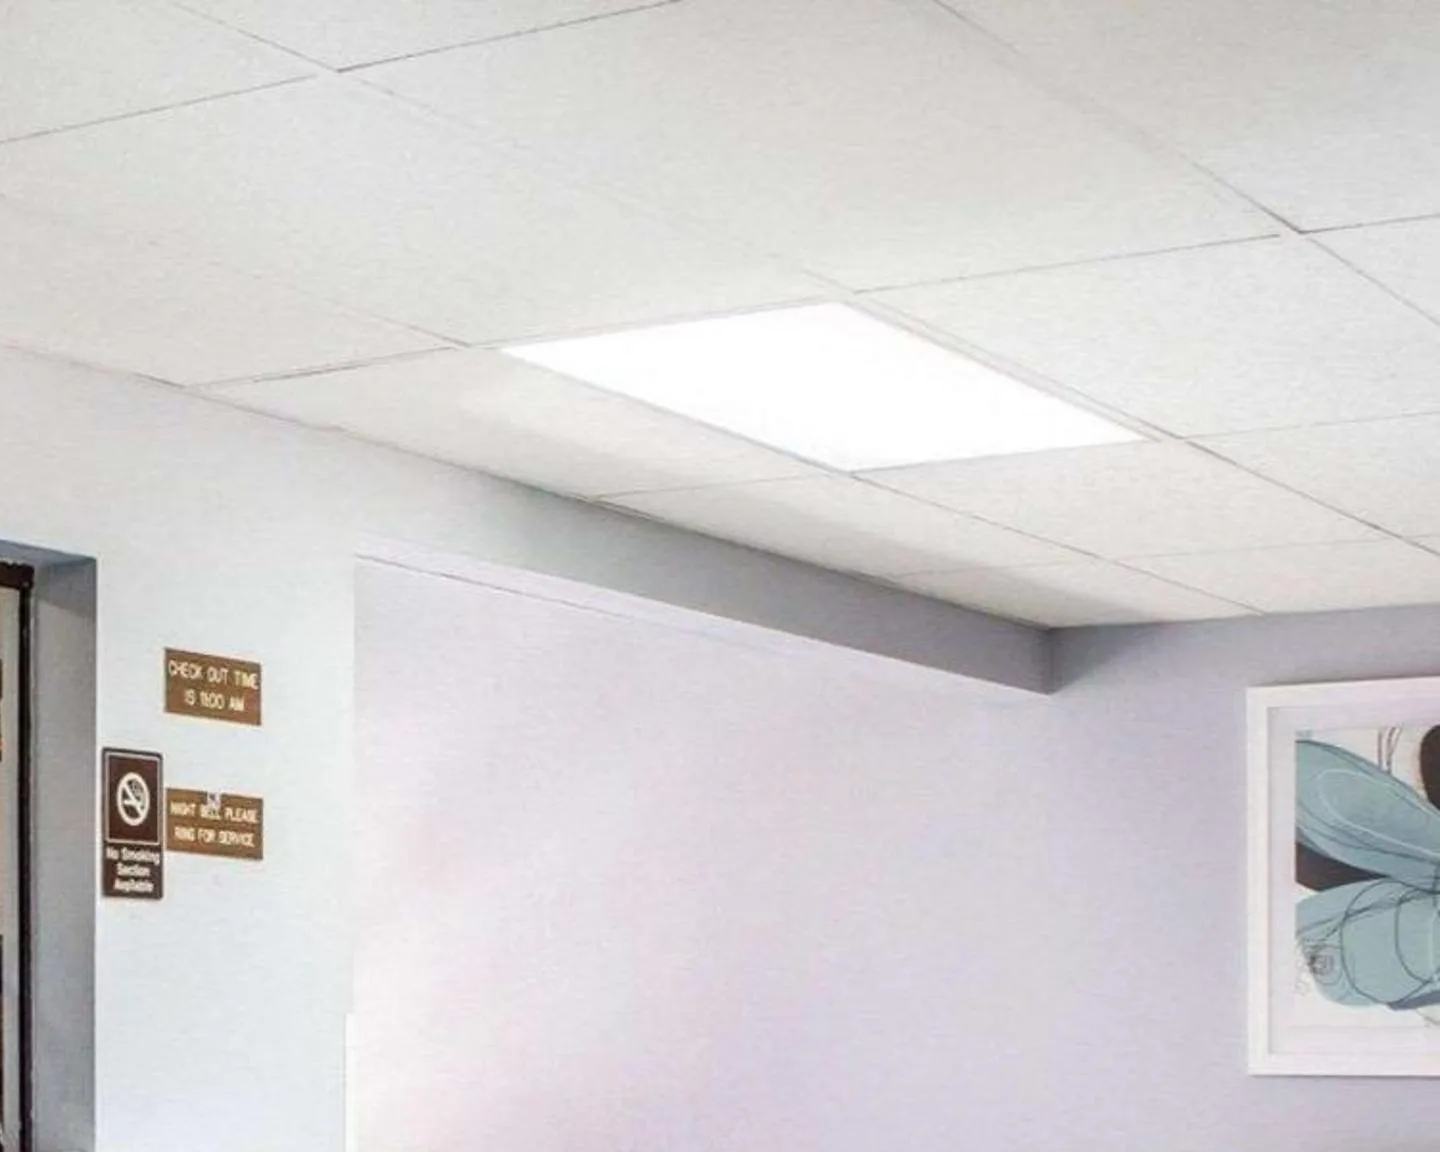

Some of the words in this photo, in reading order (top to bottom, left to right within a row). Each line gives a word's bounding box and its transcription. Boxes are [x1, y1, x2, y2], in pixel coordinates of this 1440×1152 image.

[168, 660, 202, 680] CHECK
[207, 666, 228, 684] OUT
[234, 670, 260, 690] TIME
[229, 696, 245, 712] AM
[170, 802, 196, 817] NIGHT
[224, 807, 258, 824] PLEASE
[175, 826, 196, 842] RING
[198, 828, 216, 843] FOR
[218, 830, 255, 848] SERVICE
[122, 847, 160, 866] Smoking
